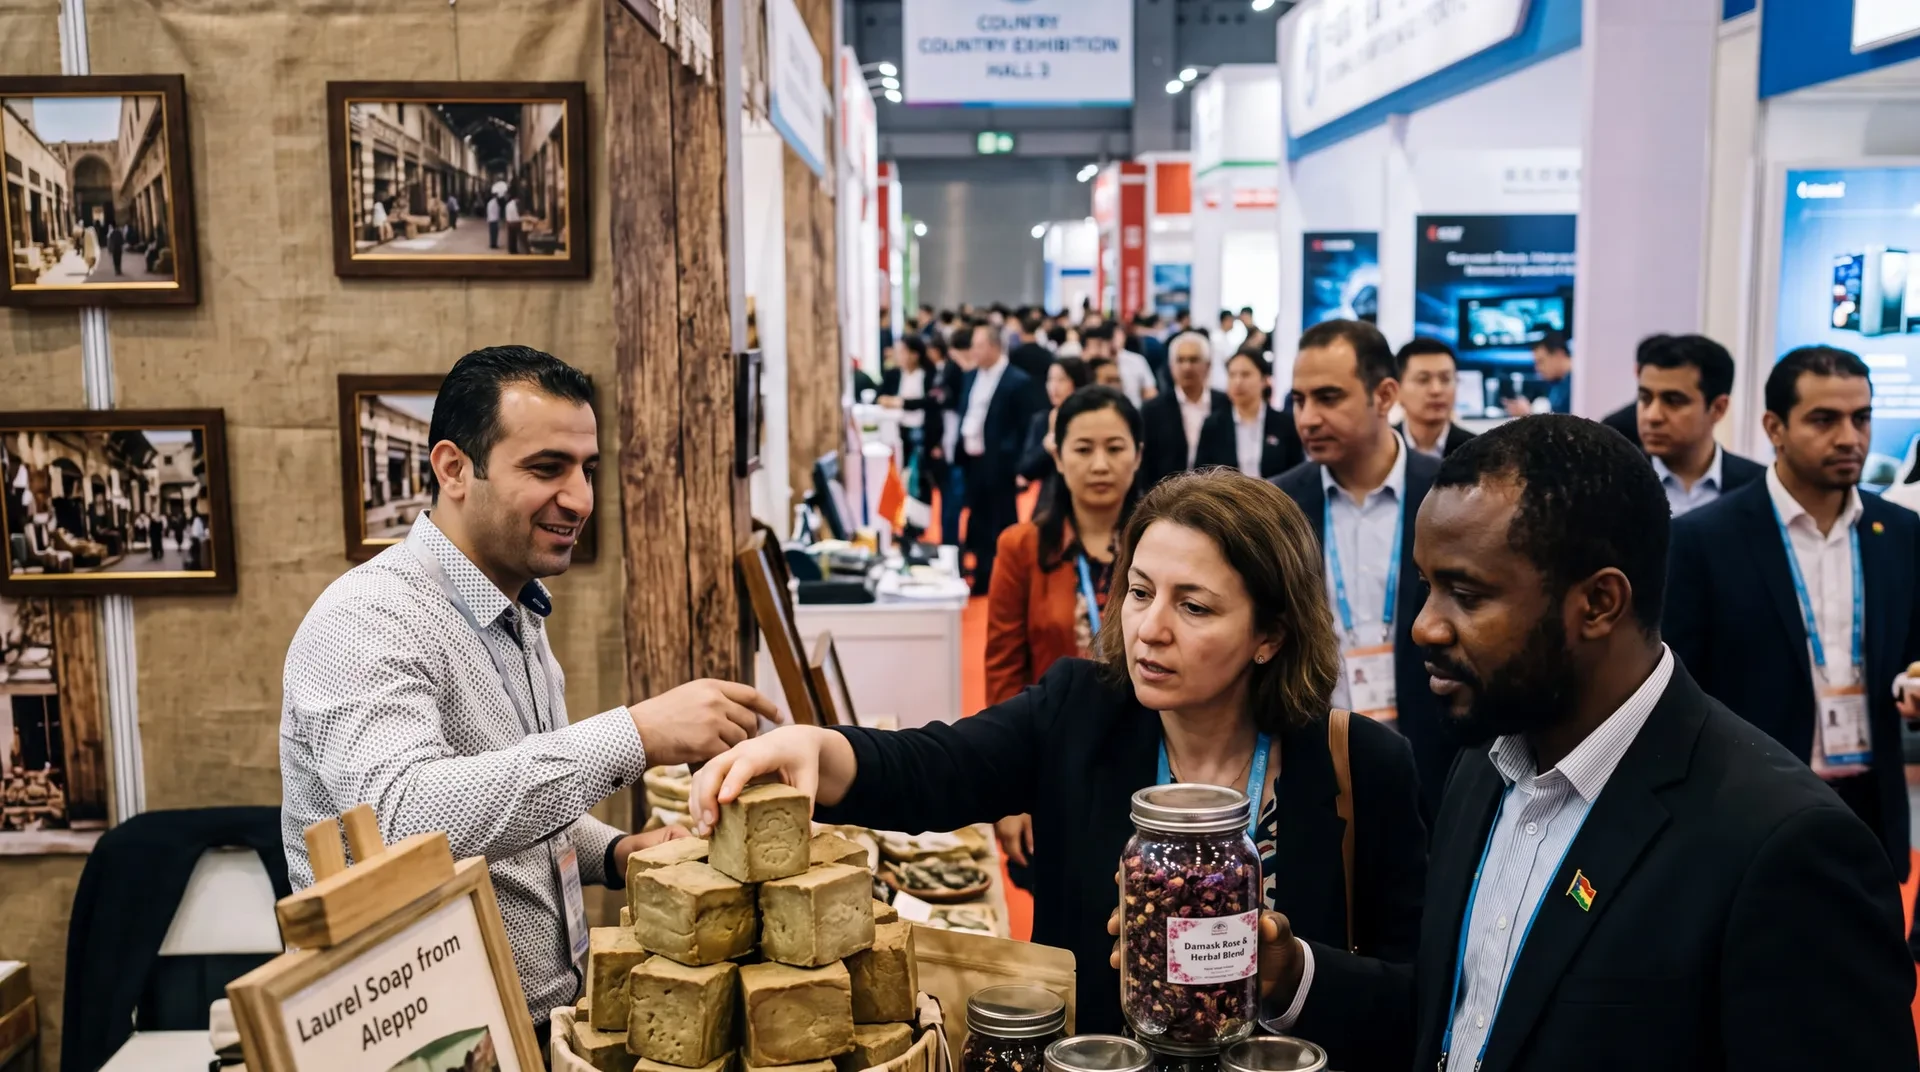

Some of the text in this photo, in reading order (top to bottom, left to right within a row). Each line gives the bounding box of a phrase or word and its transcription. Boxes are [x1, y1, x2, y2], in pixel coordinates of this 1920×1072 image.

[977, 14, 1060, 31] COUNTRY
[919, 36, 1120, 53] COUNTRY EXHIBITION
[986, 62, 1032, 78] HALL
[1184, 942, 1220, 950] Damask
[1222, 940, 1240, 948] Rose
[1191, 948, 1245, 961] Herbal Blend
[296, 935, 461, 1043] Laurel Soap from
[361, 996, 428, 1051] Aleppo
